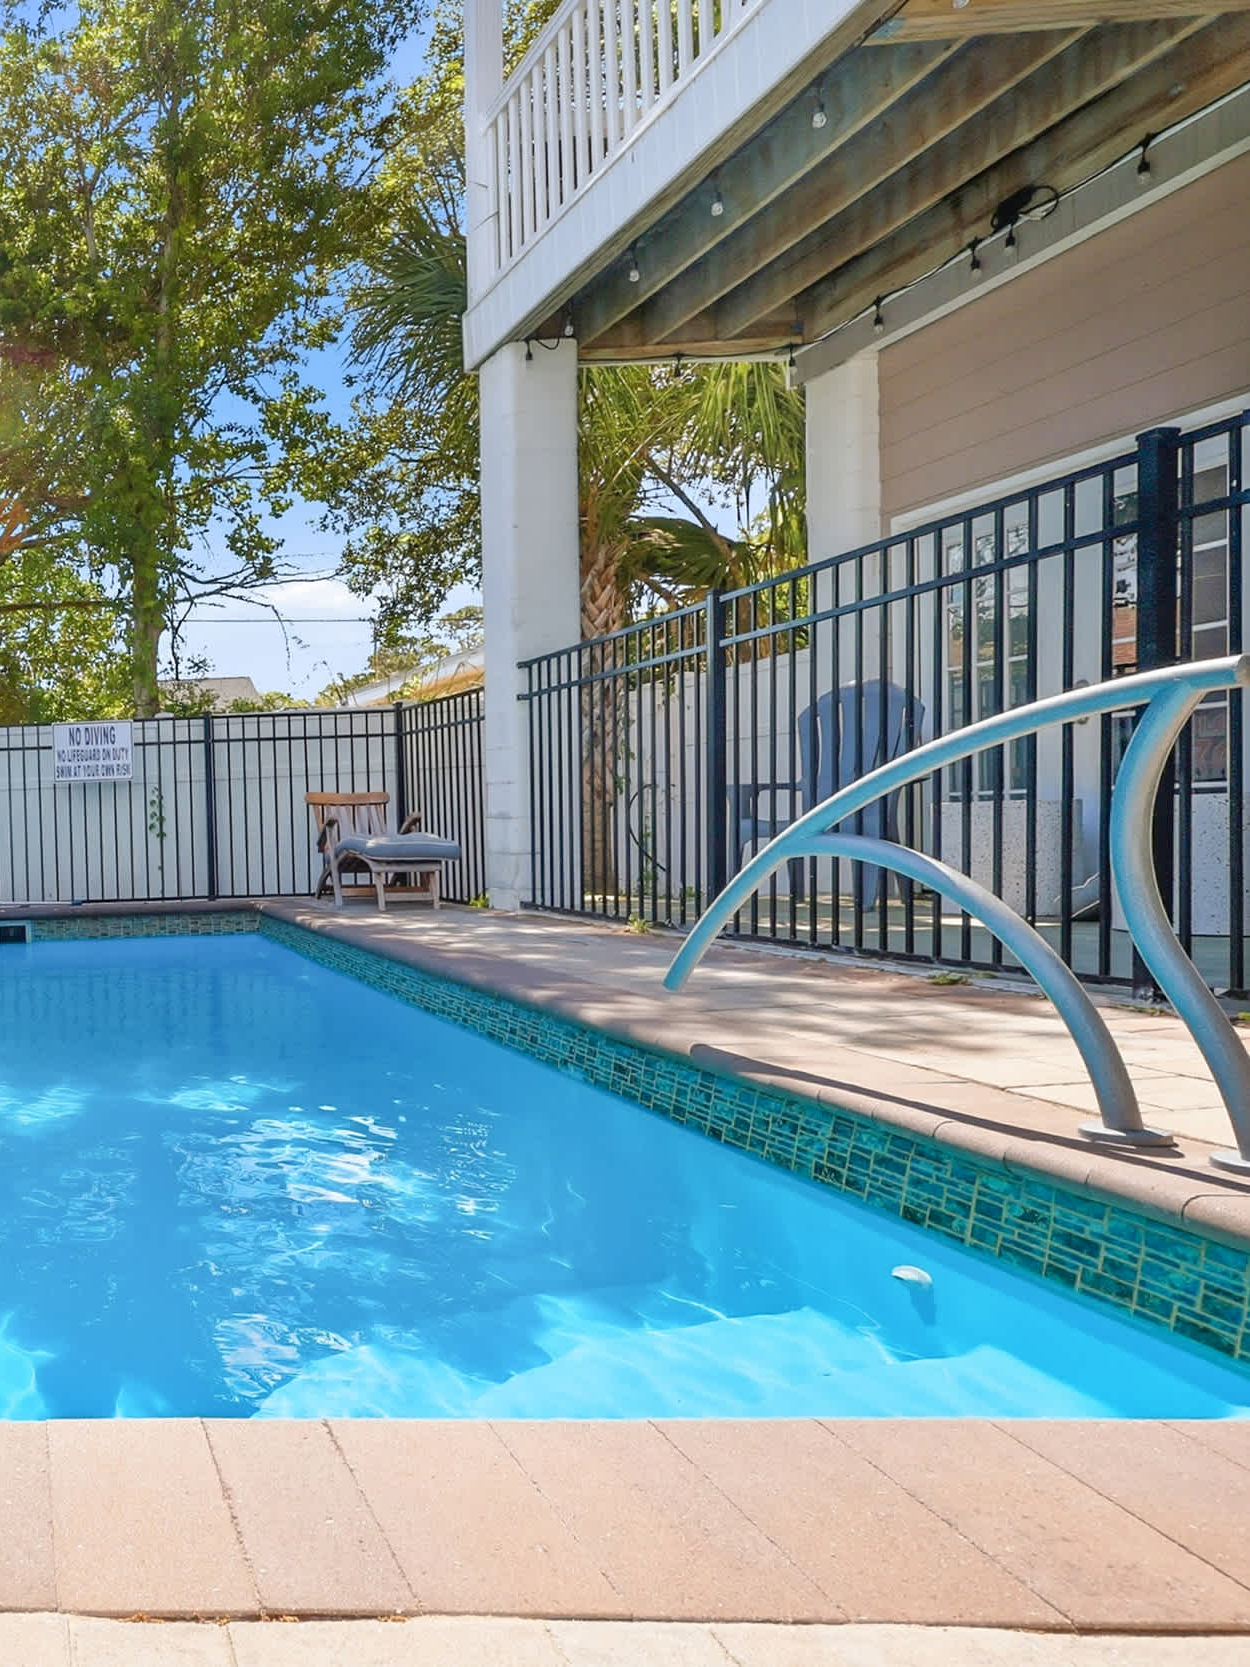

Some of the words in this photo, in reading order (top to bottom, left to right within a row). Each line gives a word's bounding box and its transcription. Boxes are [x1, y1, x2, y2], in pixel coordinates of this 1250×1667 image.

[69, 727, 81, 746] NO
[85, 726, 116, 746] DIVING
[57, 750, 66, 762] NO
[102, 748, 111, 761] ON
[112, 748, 128, 761] DUTY
